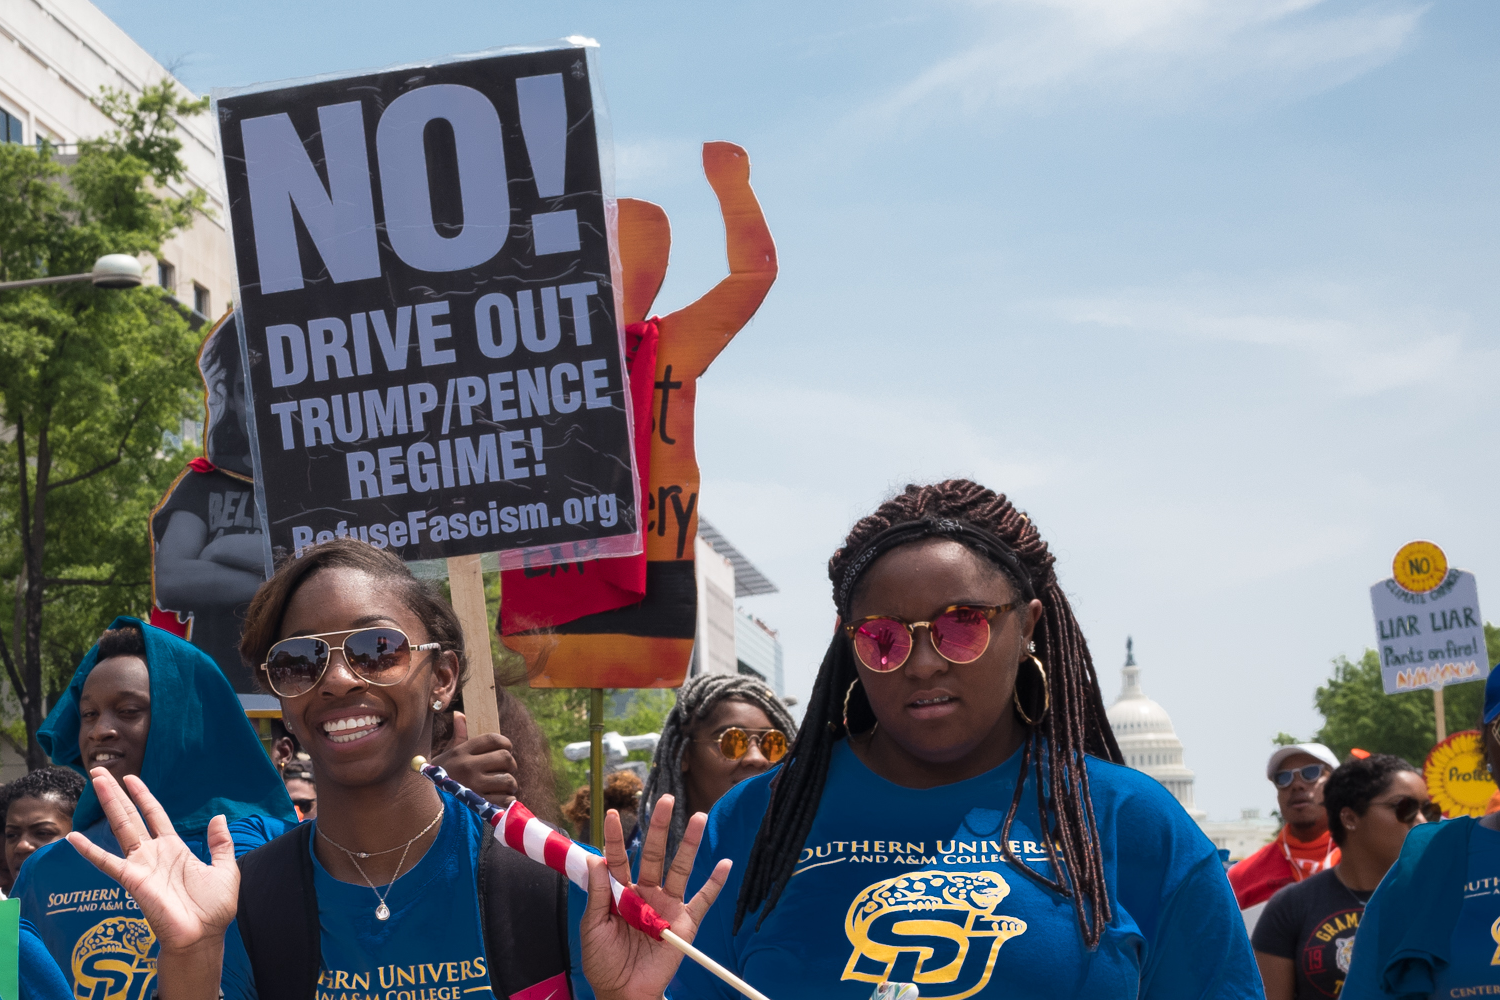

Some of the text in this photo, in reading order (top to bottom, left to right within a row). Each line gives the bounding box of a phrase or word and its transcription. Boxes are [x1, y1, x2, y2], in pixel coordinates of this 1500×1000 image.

[240, 73, 581, 295] NO!
[265, 281, 598, 388] DRIVE OUT
[271, 359, 612, 451] TRUMP/PENCE
[346, 429, 547, 501] REGIME!
[1408, 558, 1430, 575] NO
[1379, 607, 1478, 641] LIAR LIAR
[1383, 637, 1479, 667] Pants on fire!
[849, 855, 888, 863] AND
[893, 854, 936, 864] A&M
[47, 888, 120, 907] SOUTHERN
[77, 903, 98, 912] AND
[99, 901, 123, 911] A&M
[1308, 949, 1323, 971] 19
